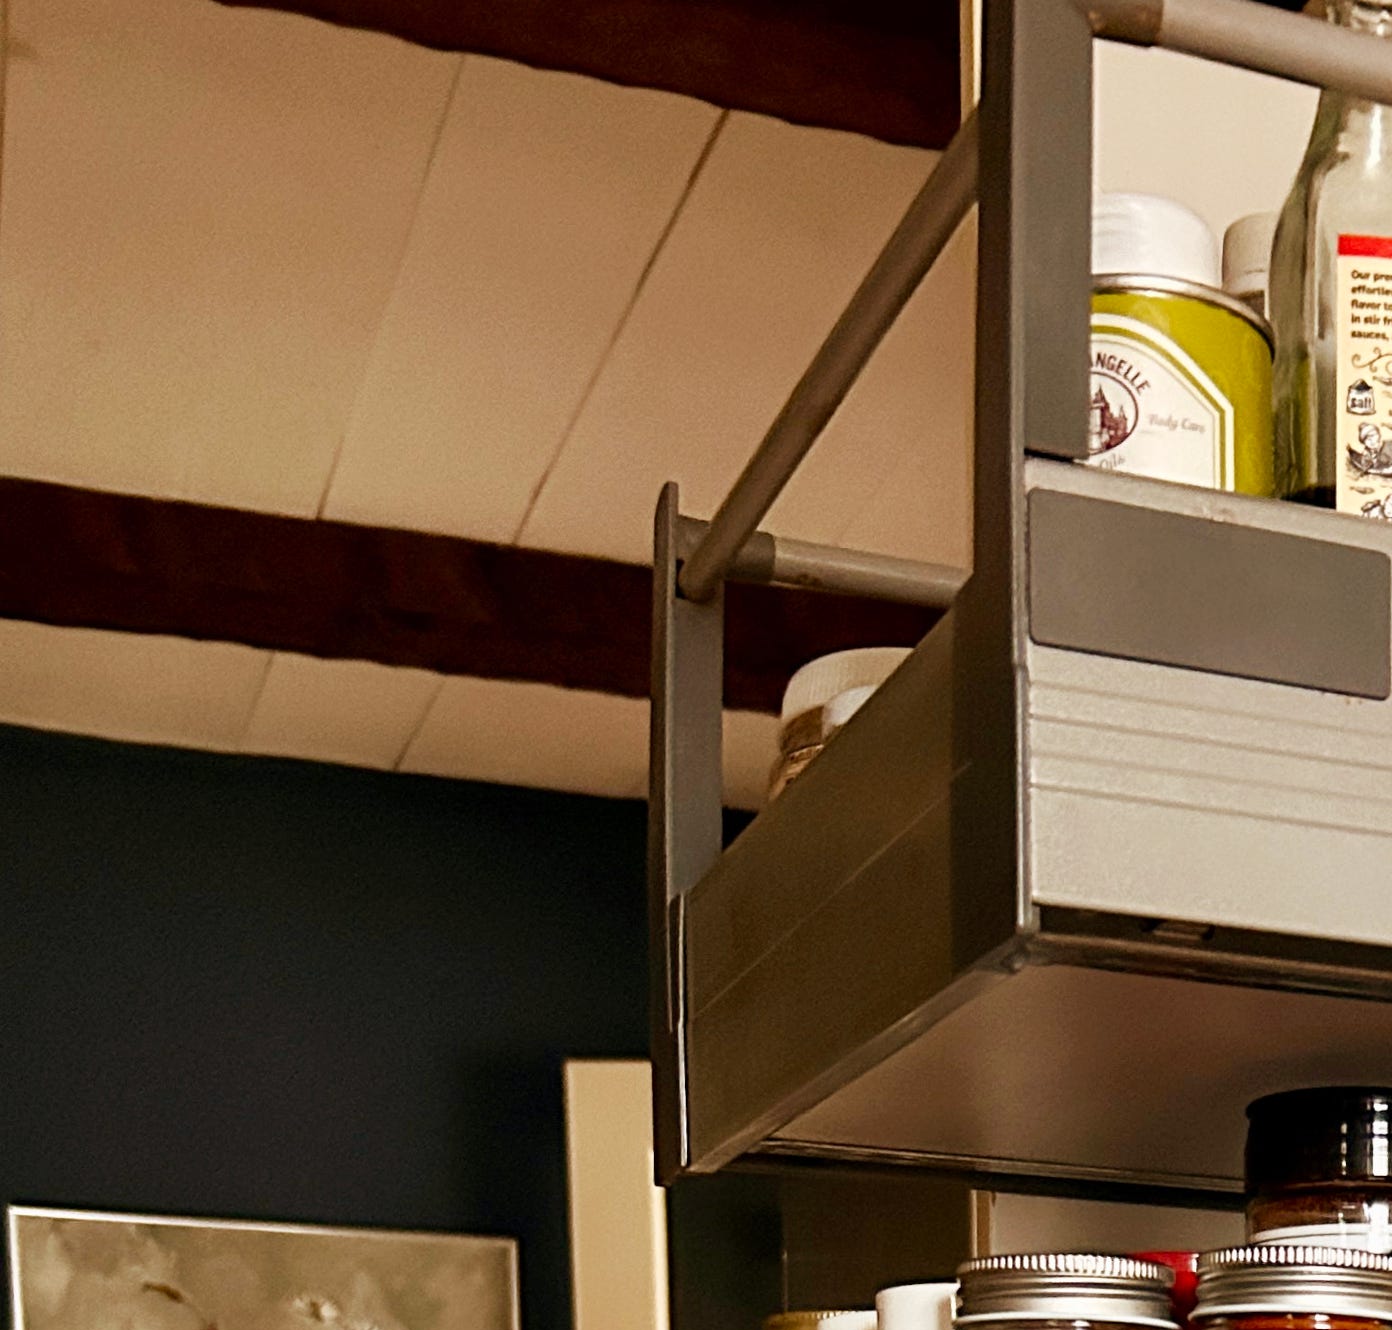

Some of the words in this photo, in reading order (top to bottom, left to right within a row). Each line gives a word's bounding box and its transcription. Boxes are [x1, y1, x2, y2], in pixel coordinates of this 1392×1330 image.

[1351, 270, 1370, 280] Our
[1351, 299, 1381, 310] flavor
[1351, 314, 1360, 324] in
[1364, 315, 1380, 324] stir
